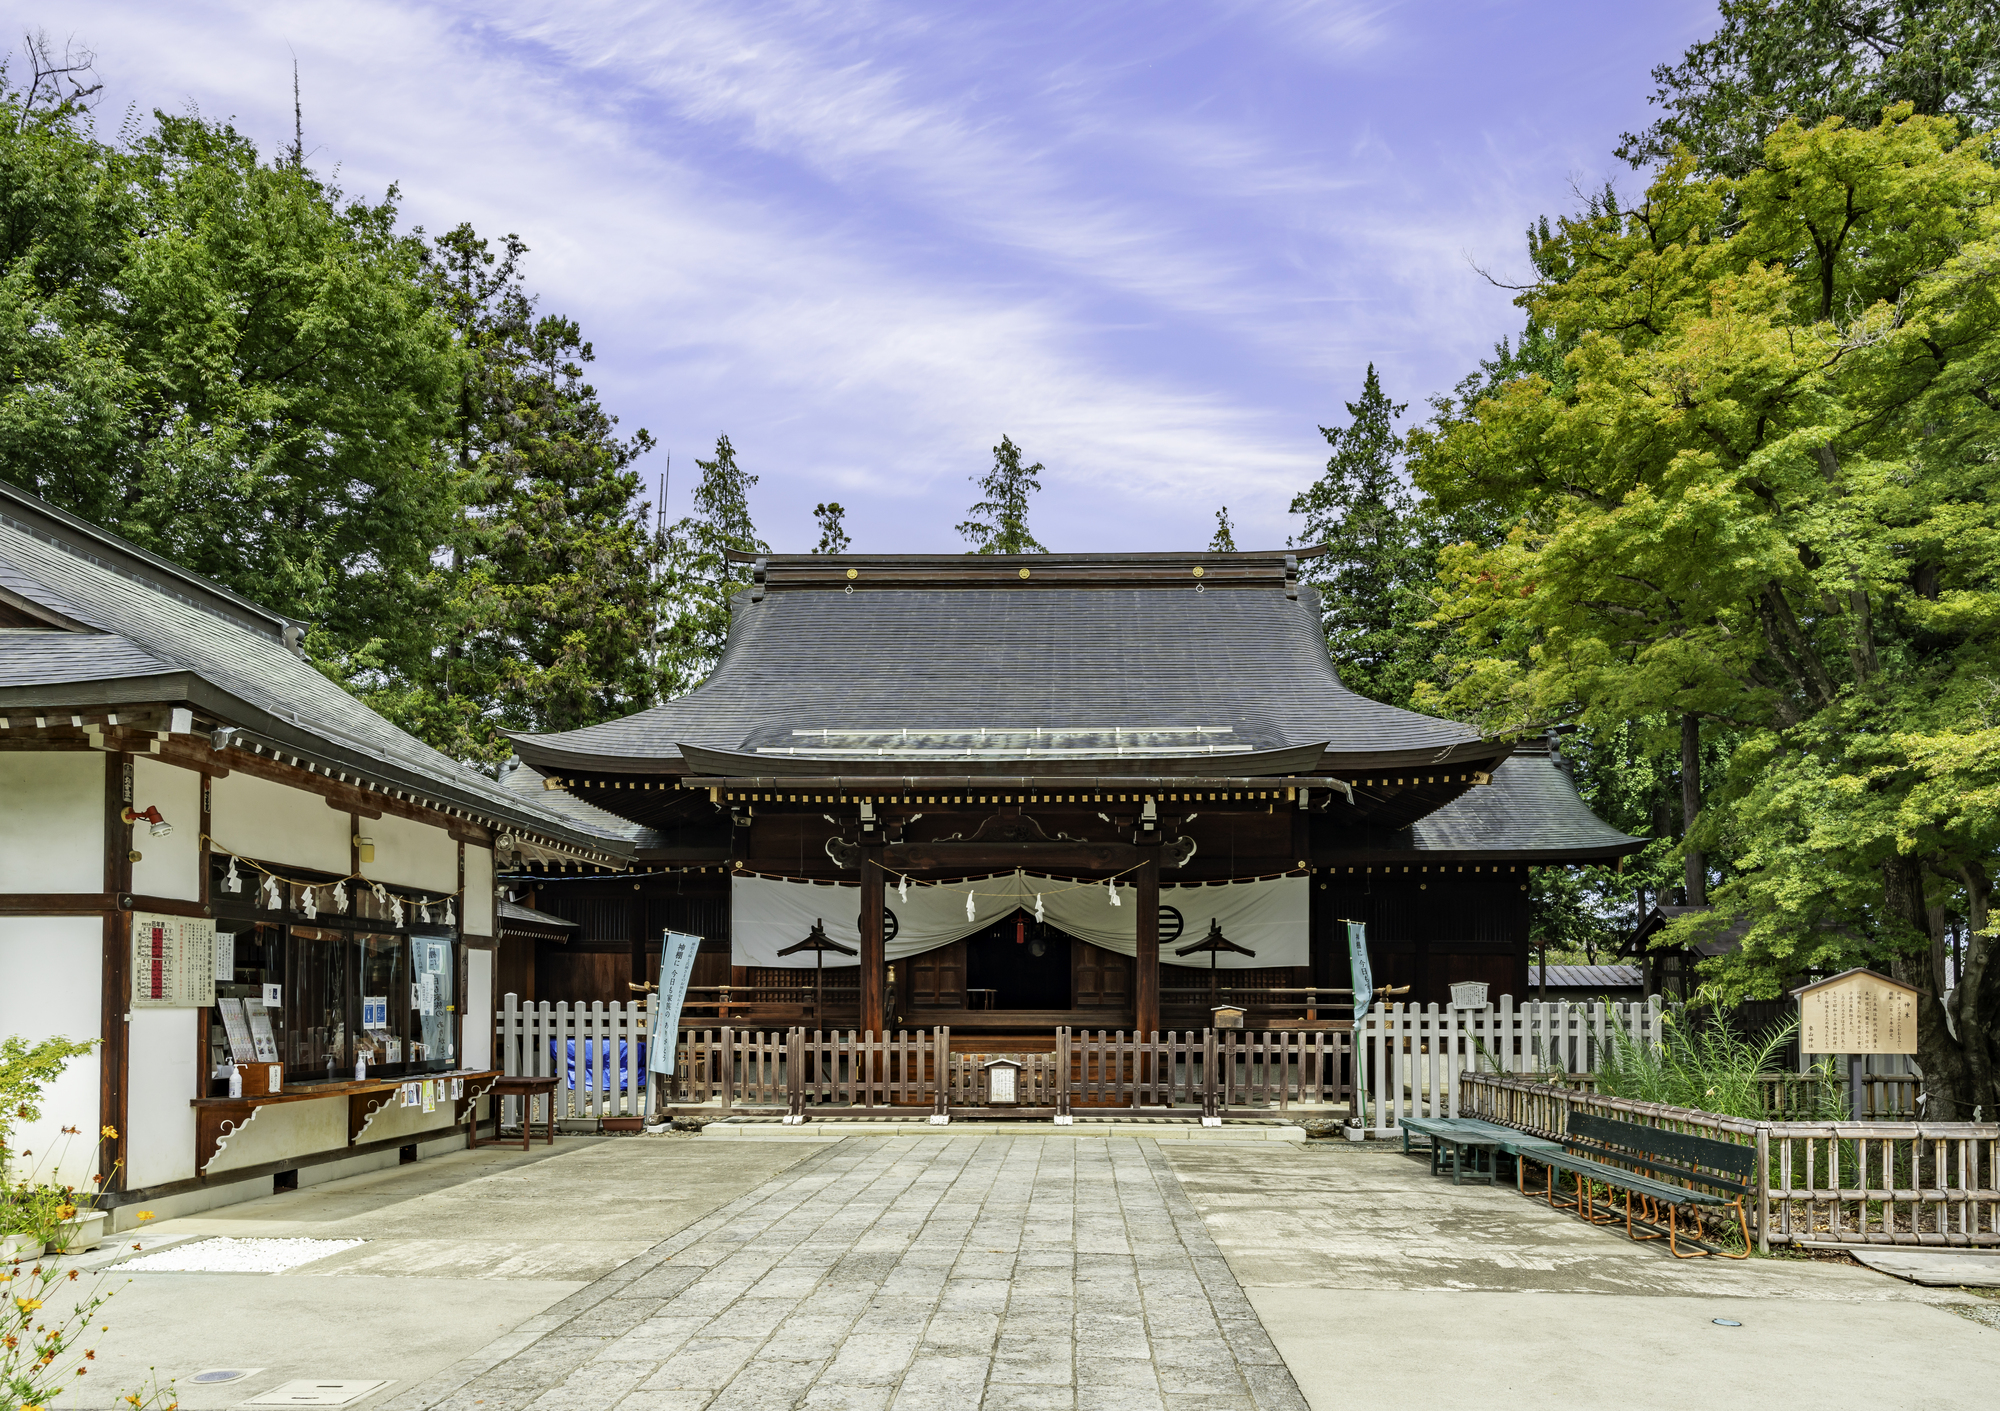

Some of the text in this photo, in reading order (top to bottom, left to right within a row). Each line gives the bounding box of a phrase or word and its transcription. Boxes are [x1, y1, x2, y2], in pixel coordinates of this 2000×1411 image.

[673, 942, 686, 967] 神棚に
[664, 969, 678, 1019] 今日も家族の
[1905, 1002, 1911, 1019] 神木
